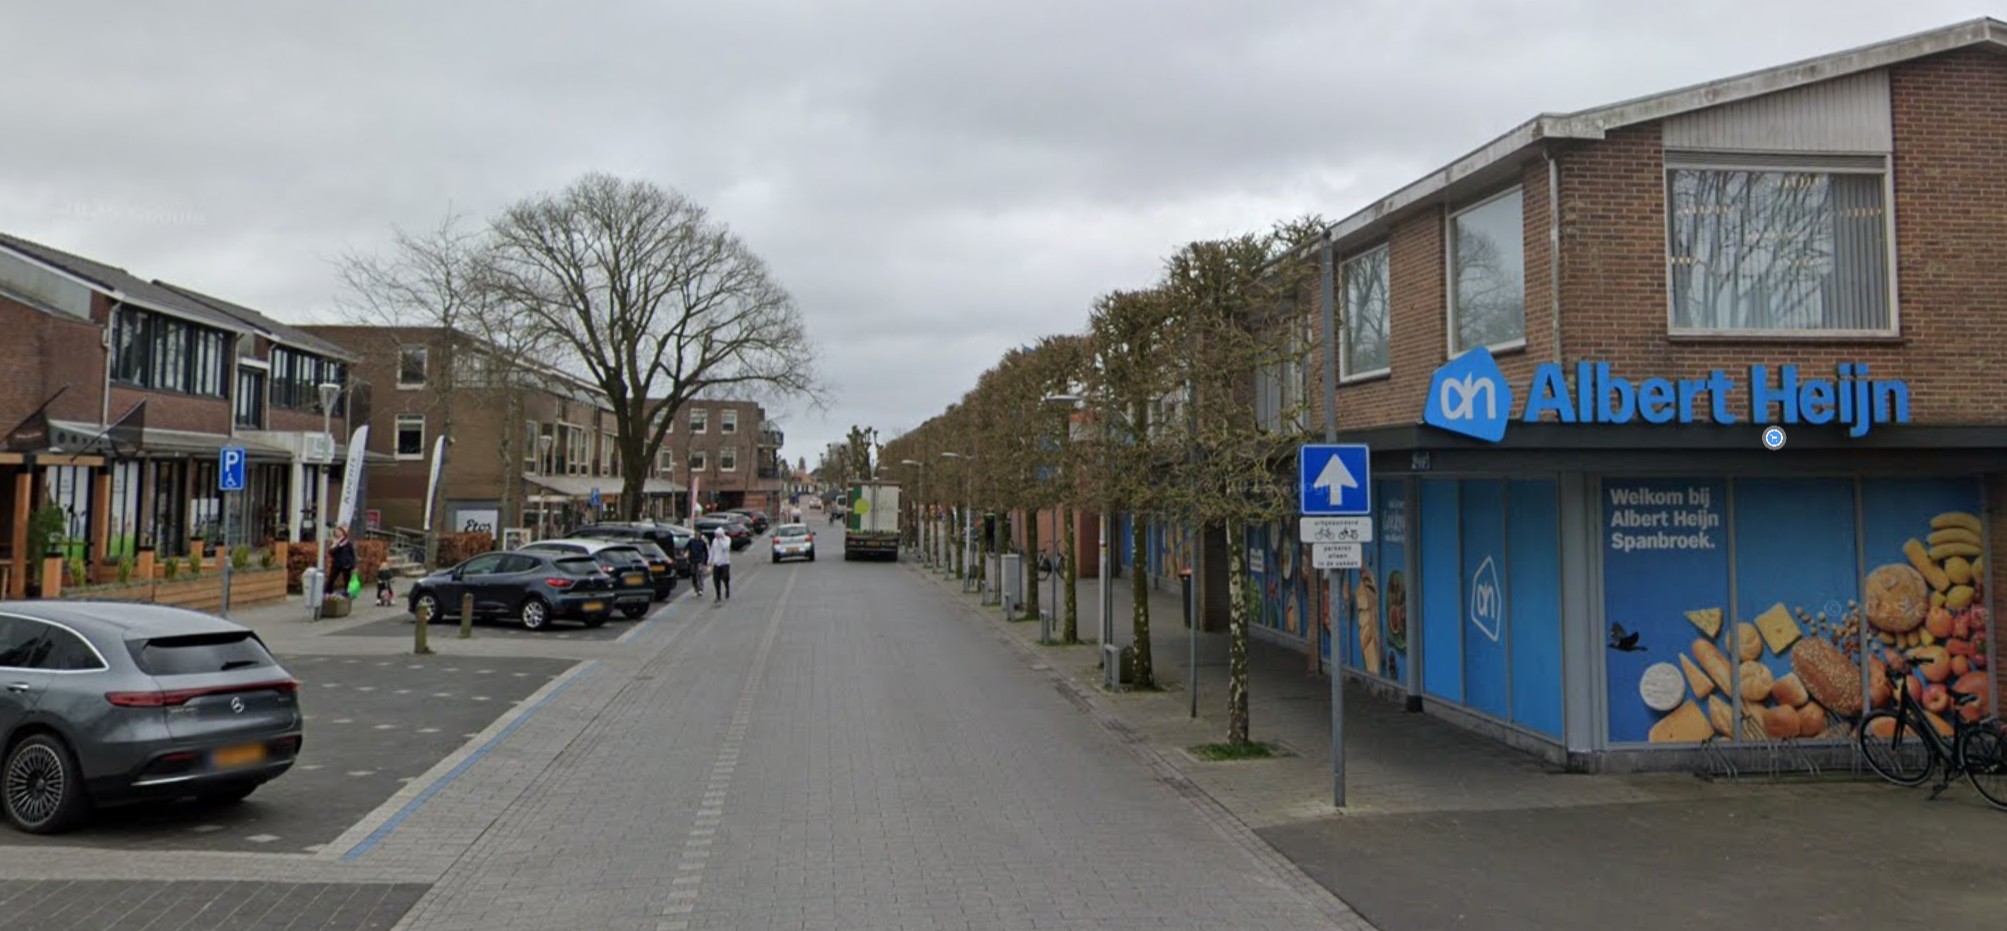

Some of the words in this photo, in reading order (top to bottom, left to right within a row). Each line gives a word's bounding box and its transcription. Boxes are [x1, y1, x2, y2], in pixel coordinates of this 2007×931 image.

[1523, 360, 1736, 424] Albert
[1750, 361, 1911, 438] Heijn
[225, 451, 239, 472] P
[1610, 488, 1684, 505] Welkom
[1688, 487, 1710, 509] bij
[1611, 510, 1669, 527] Albert
[1673, 510, 1719, 530] Heijn
[1611, 531, 1716, 553] Spanbroek.
